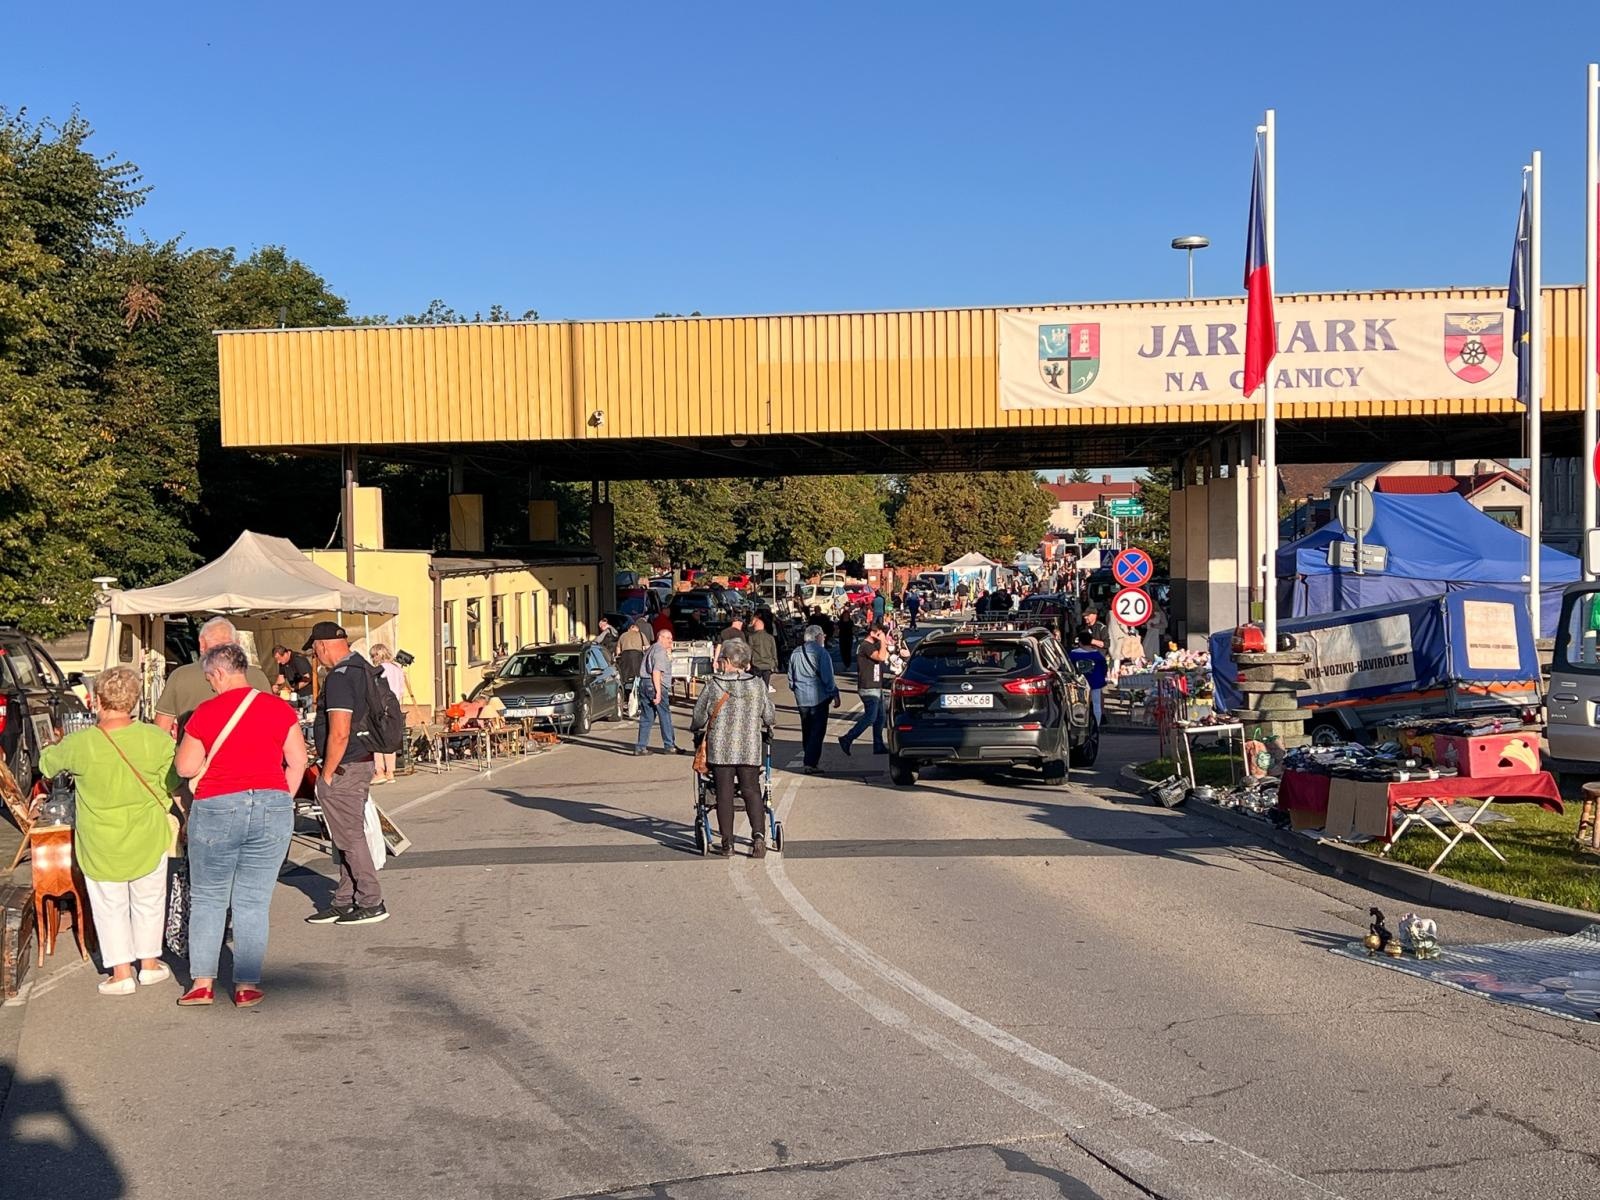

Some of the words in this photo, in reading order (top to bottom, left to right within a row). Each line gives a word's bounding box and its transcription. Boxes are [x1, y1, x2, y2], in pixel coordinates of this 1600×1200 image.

[1138, 319, 1400, 358] JARARK
[1165, 371, 1210, 392] NA
[1229, 367, 1365, 390] GANICY
[1119, 598, 1146, 615] 20
